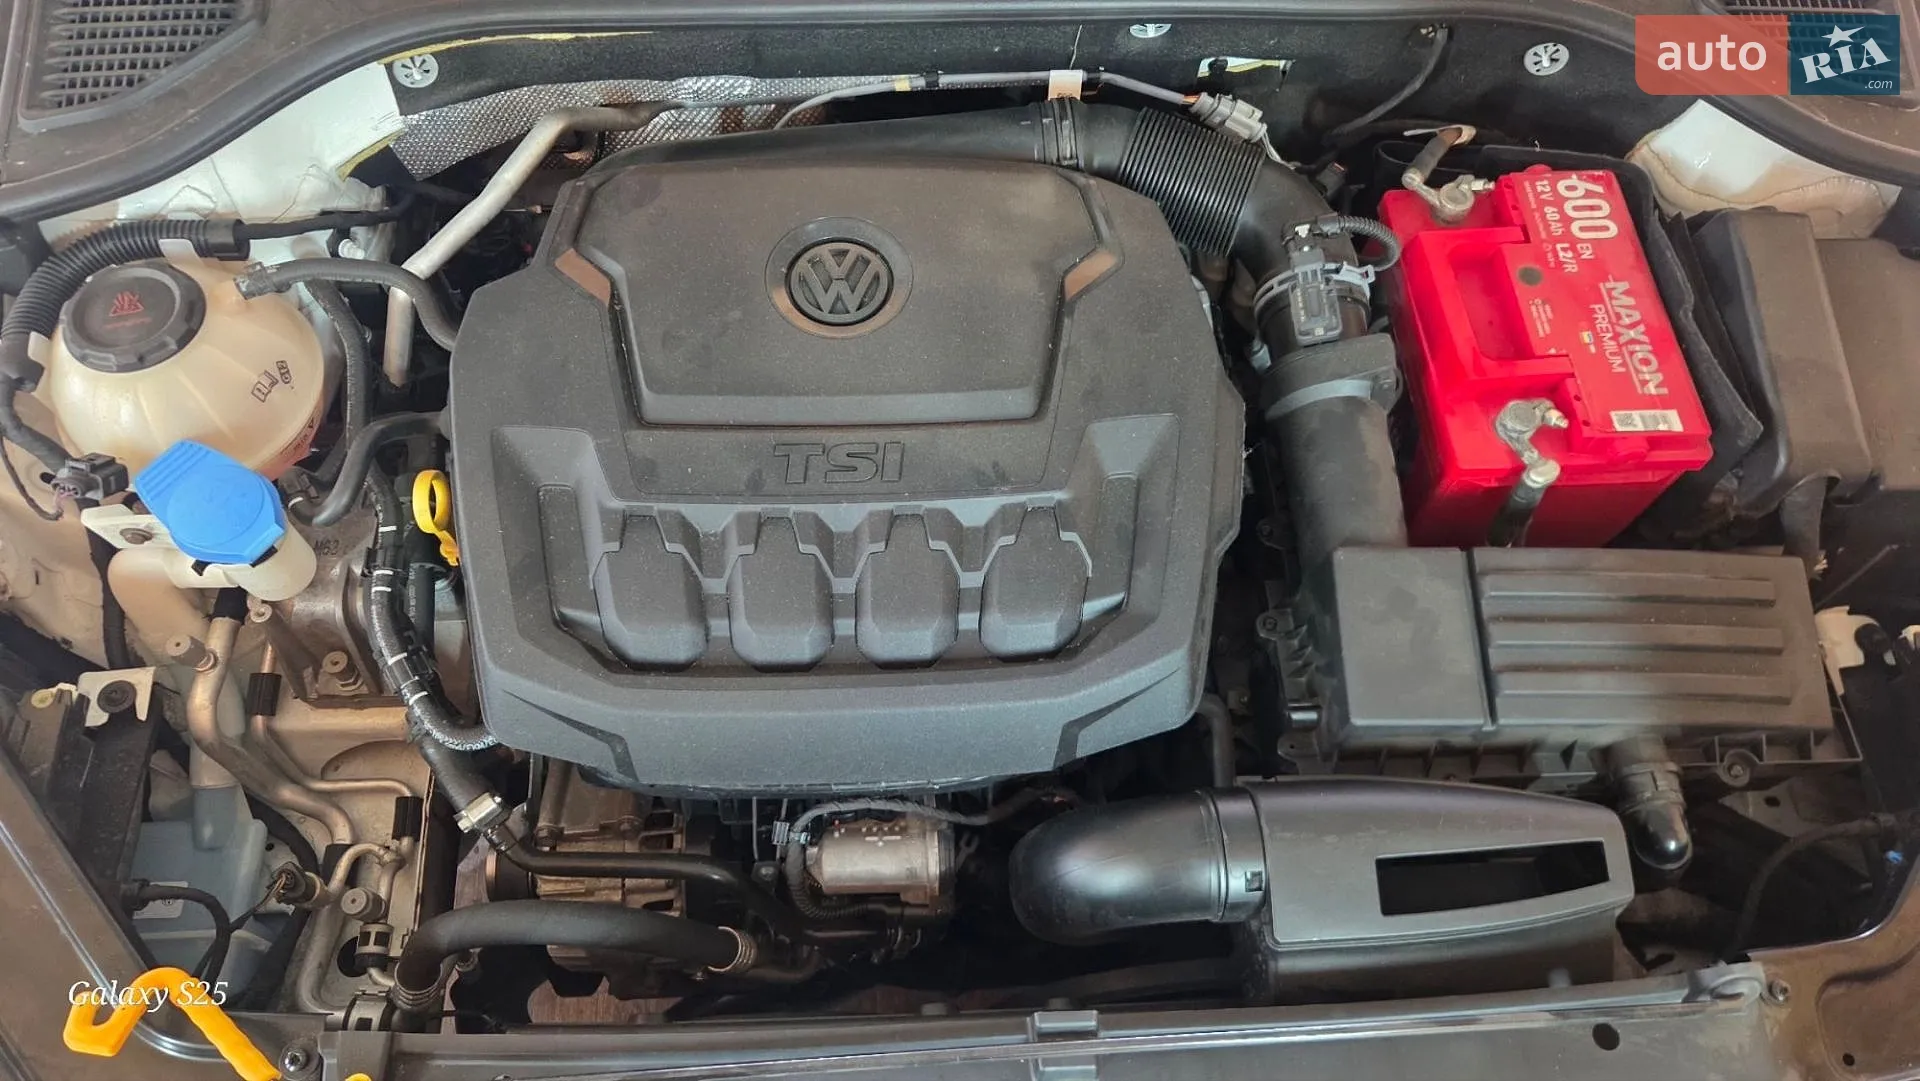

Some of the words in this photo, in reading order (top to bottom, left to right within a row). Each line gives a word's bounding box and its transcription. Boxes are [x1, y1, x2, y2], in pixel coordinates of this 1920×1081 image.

[1535, 179, 1554, 201] 12V
[1556, 176, 1618, 239] 600
[1576, 243, 1594, 260] EN
[1590, 303, 1626, 373] PREMIUM
[1604, 275, 1669, 395] MAXION
[774, 442, 905, 484] TSI
